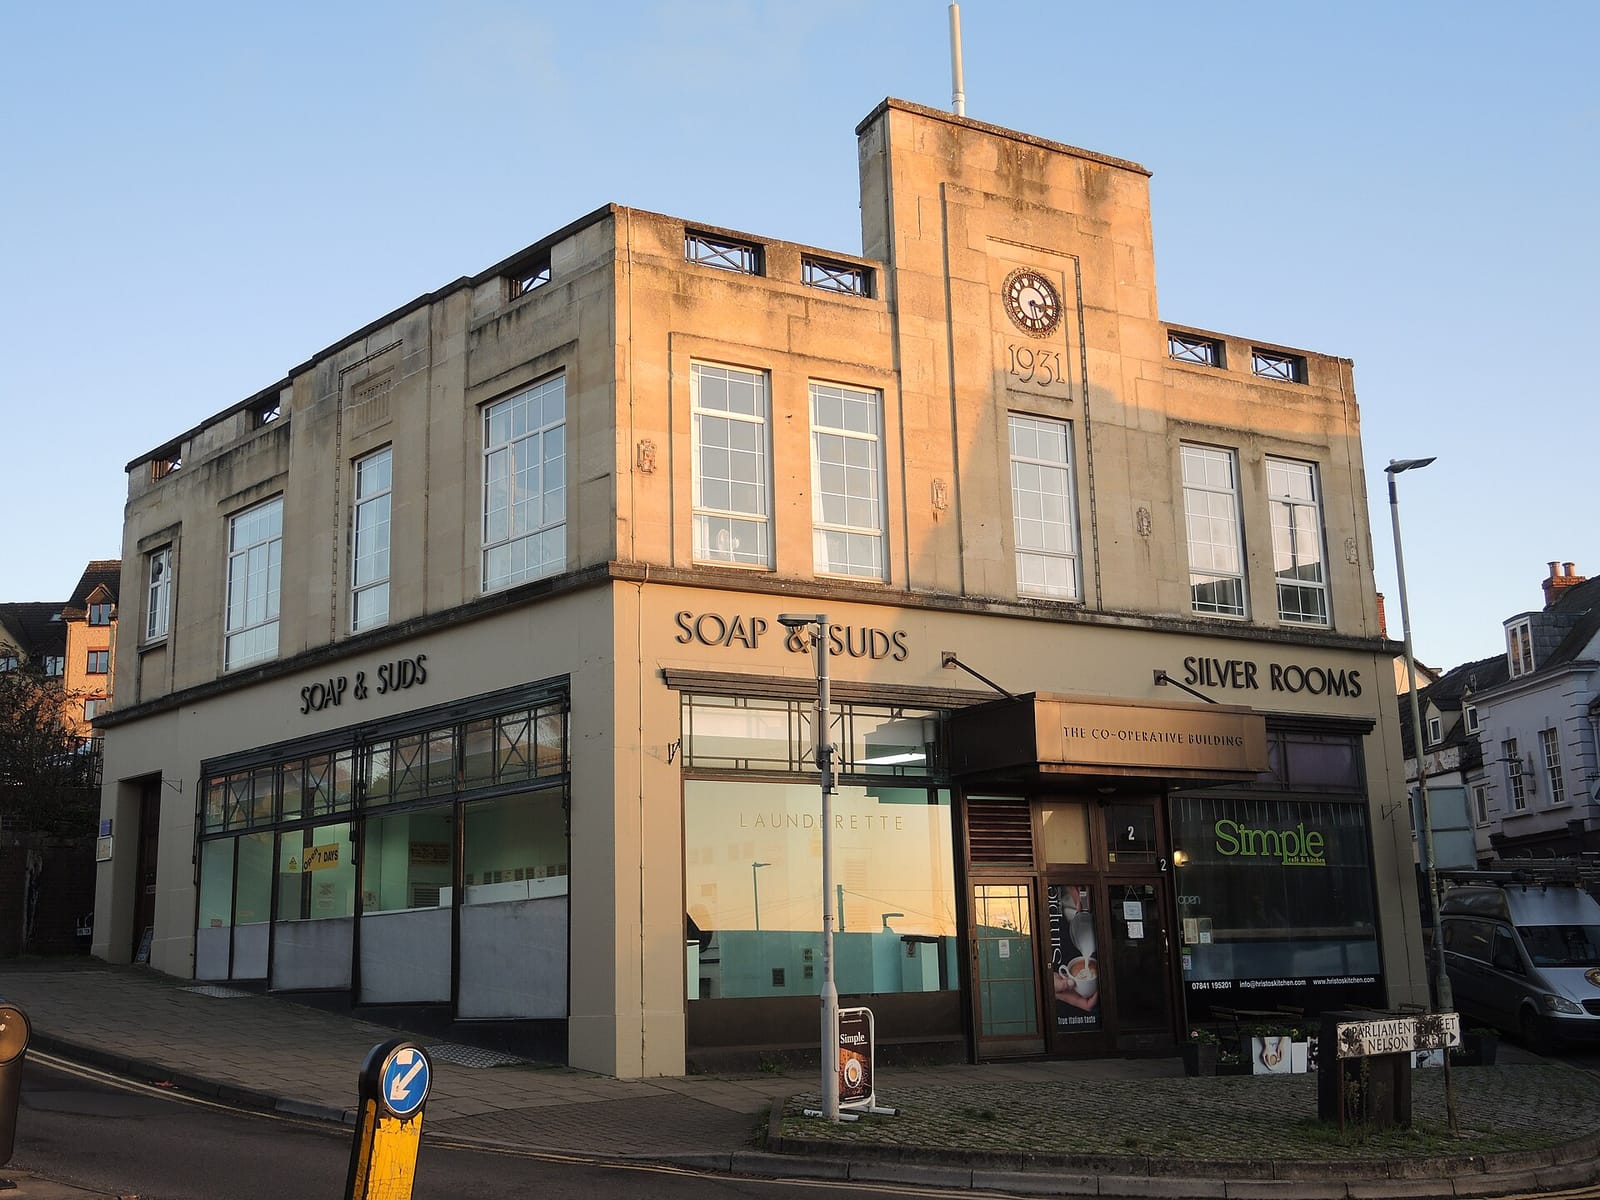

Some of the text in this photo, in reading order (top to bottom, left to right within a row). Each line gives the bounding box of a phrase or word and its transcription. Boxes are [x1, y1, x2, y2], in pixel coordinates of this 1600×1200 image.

[1008, 343, 1065, 387] 1931
[675, 610, 909, 661] SOAP & SUDS
[300, 654, 427, 715] SOAP & SUDS
[1184, 656, 1362, 698] SILVER ROOMS
[1063, 726, 1244, 747] THE CO-OPERATIVE BUILDING
[1127, 826, 1135, 840] 2
[1215, 819, 1325, 866] Simple
[317, 852, 323, 863] 7
[323, 849, 339, 862] DAYS
[1160, 858, 1167, 871] 2
[839, 1031, 865, 1046] Simple
[1351, 1020, 1417, 1039] PARLIAMENT
[1368, 1036, 1409, 1053] NELSON
